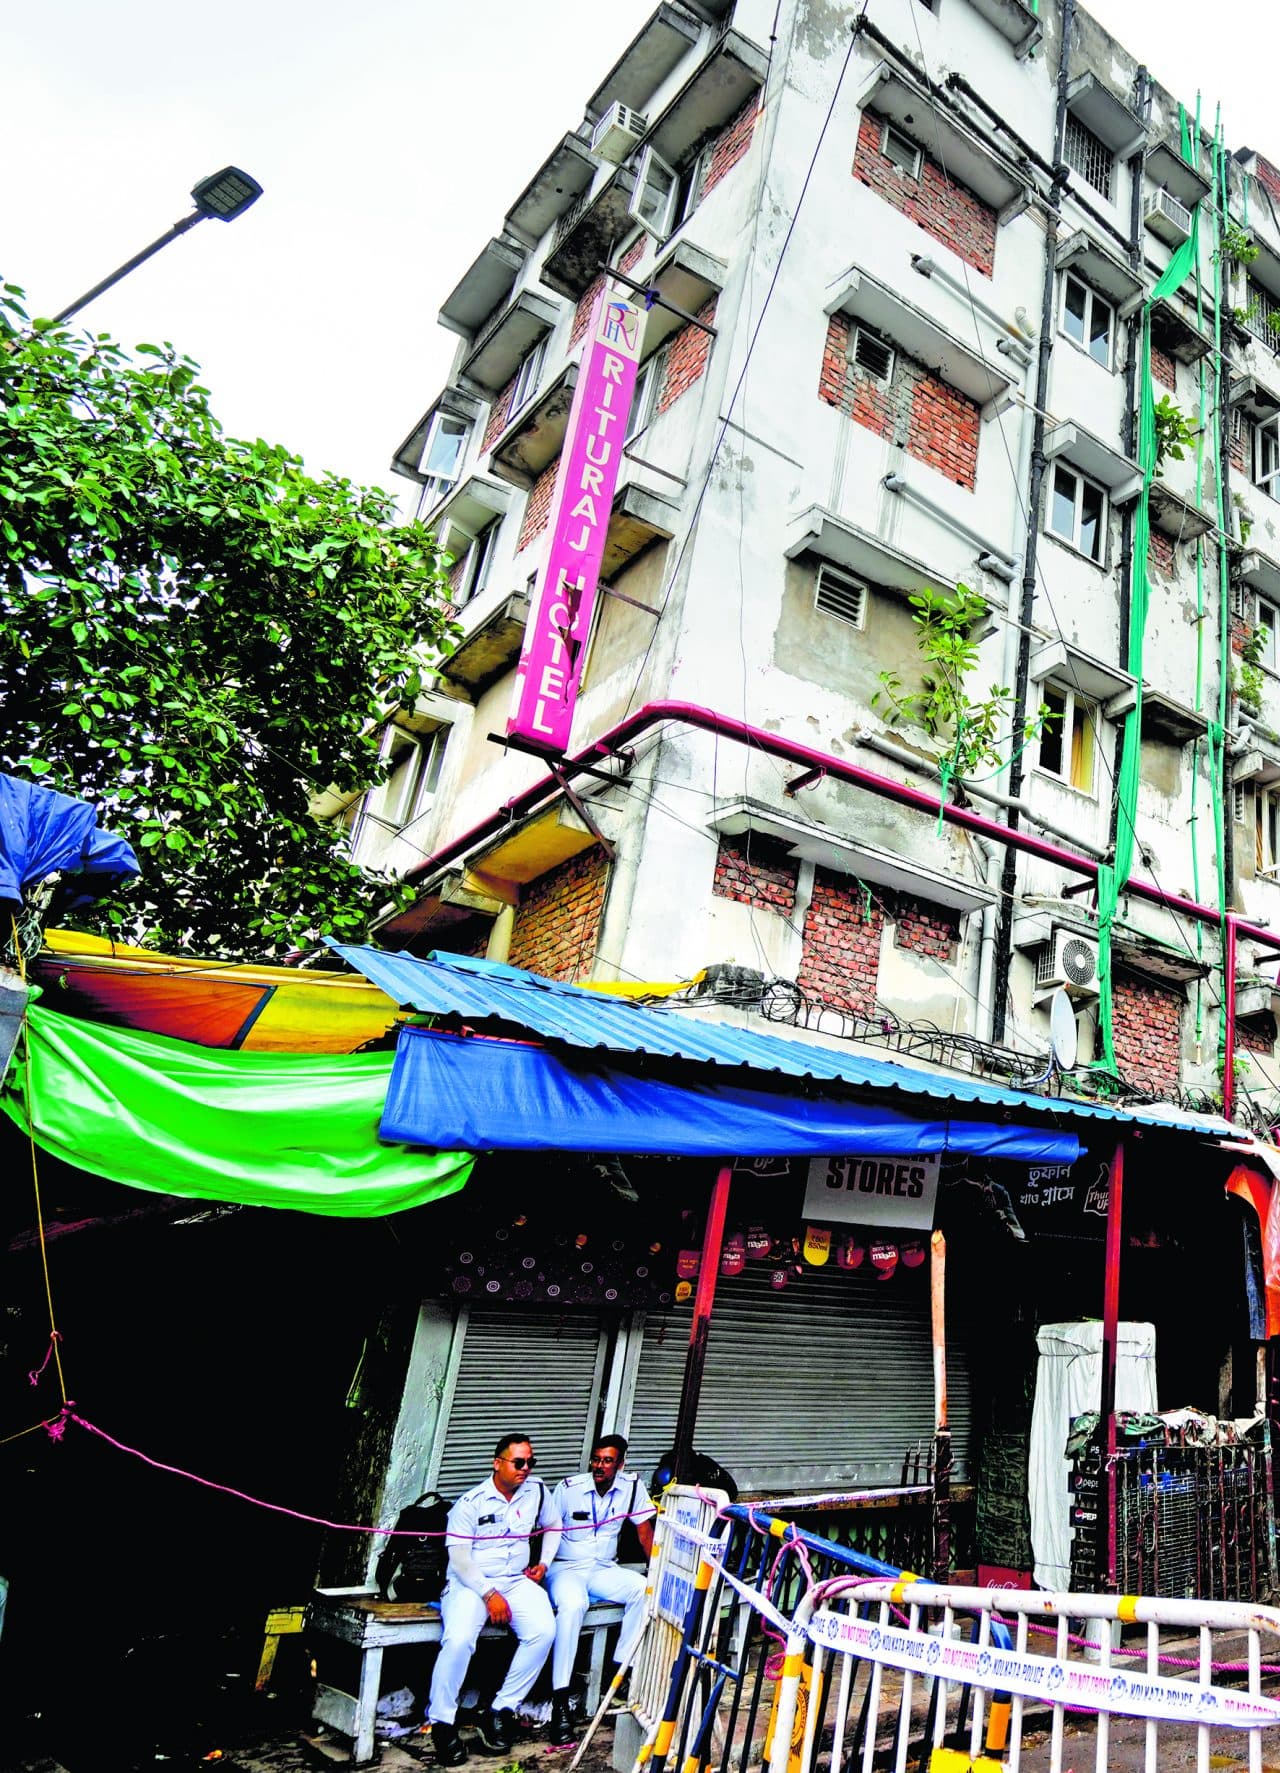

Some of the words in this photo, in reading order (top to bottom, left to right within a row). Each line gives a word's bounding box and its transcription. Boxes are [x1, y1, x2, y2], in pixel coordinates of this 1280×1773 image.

[569, 352, 625, 552] RITURAJ
[532, 567, 586, 735] HOTEL
[826, 1158, 925, 1199] STORES
[841, 1623, 848, 1639] DO
[848, 1625, 857, 1641] NOT
[882, 1635, 905, 1653] KOLKATA
[906, 1640, 925, 1659] POLICE
[942, 1647, 951, 1664] DO
[951, 1649, 962, 1666] NOT
[993, 1659, 1021, 1677] KOLKATA
[1021, 1664, 1044, 1684] POLICE
[1130, 1683, 1164, 1702] KOLKATA
[1166, 1690, 1193, 1707] POLICE
